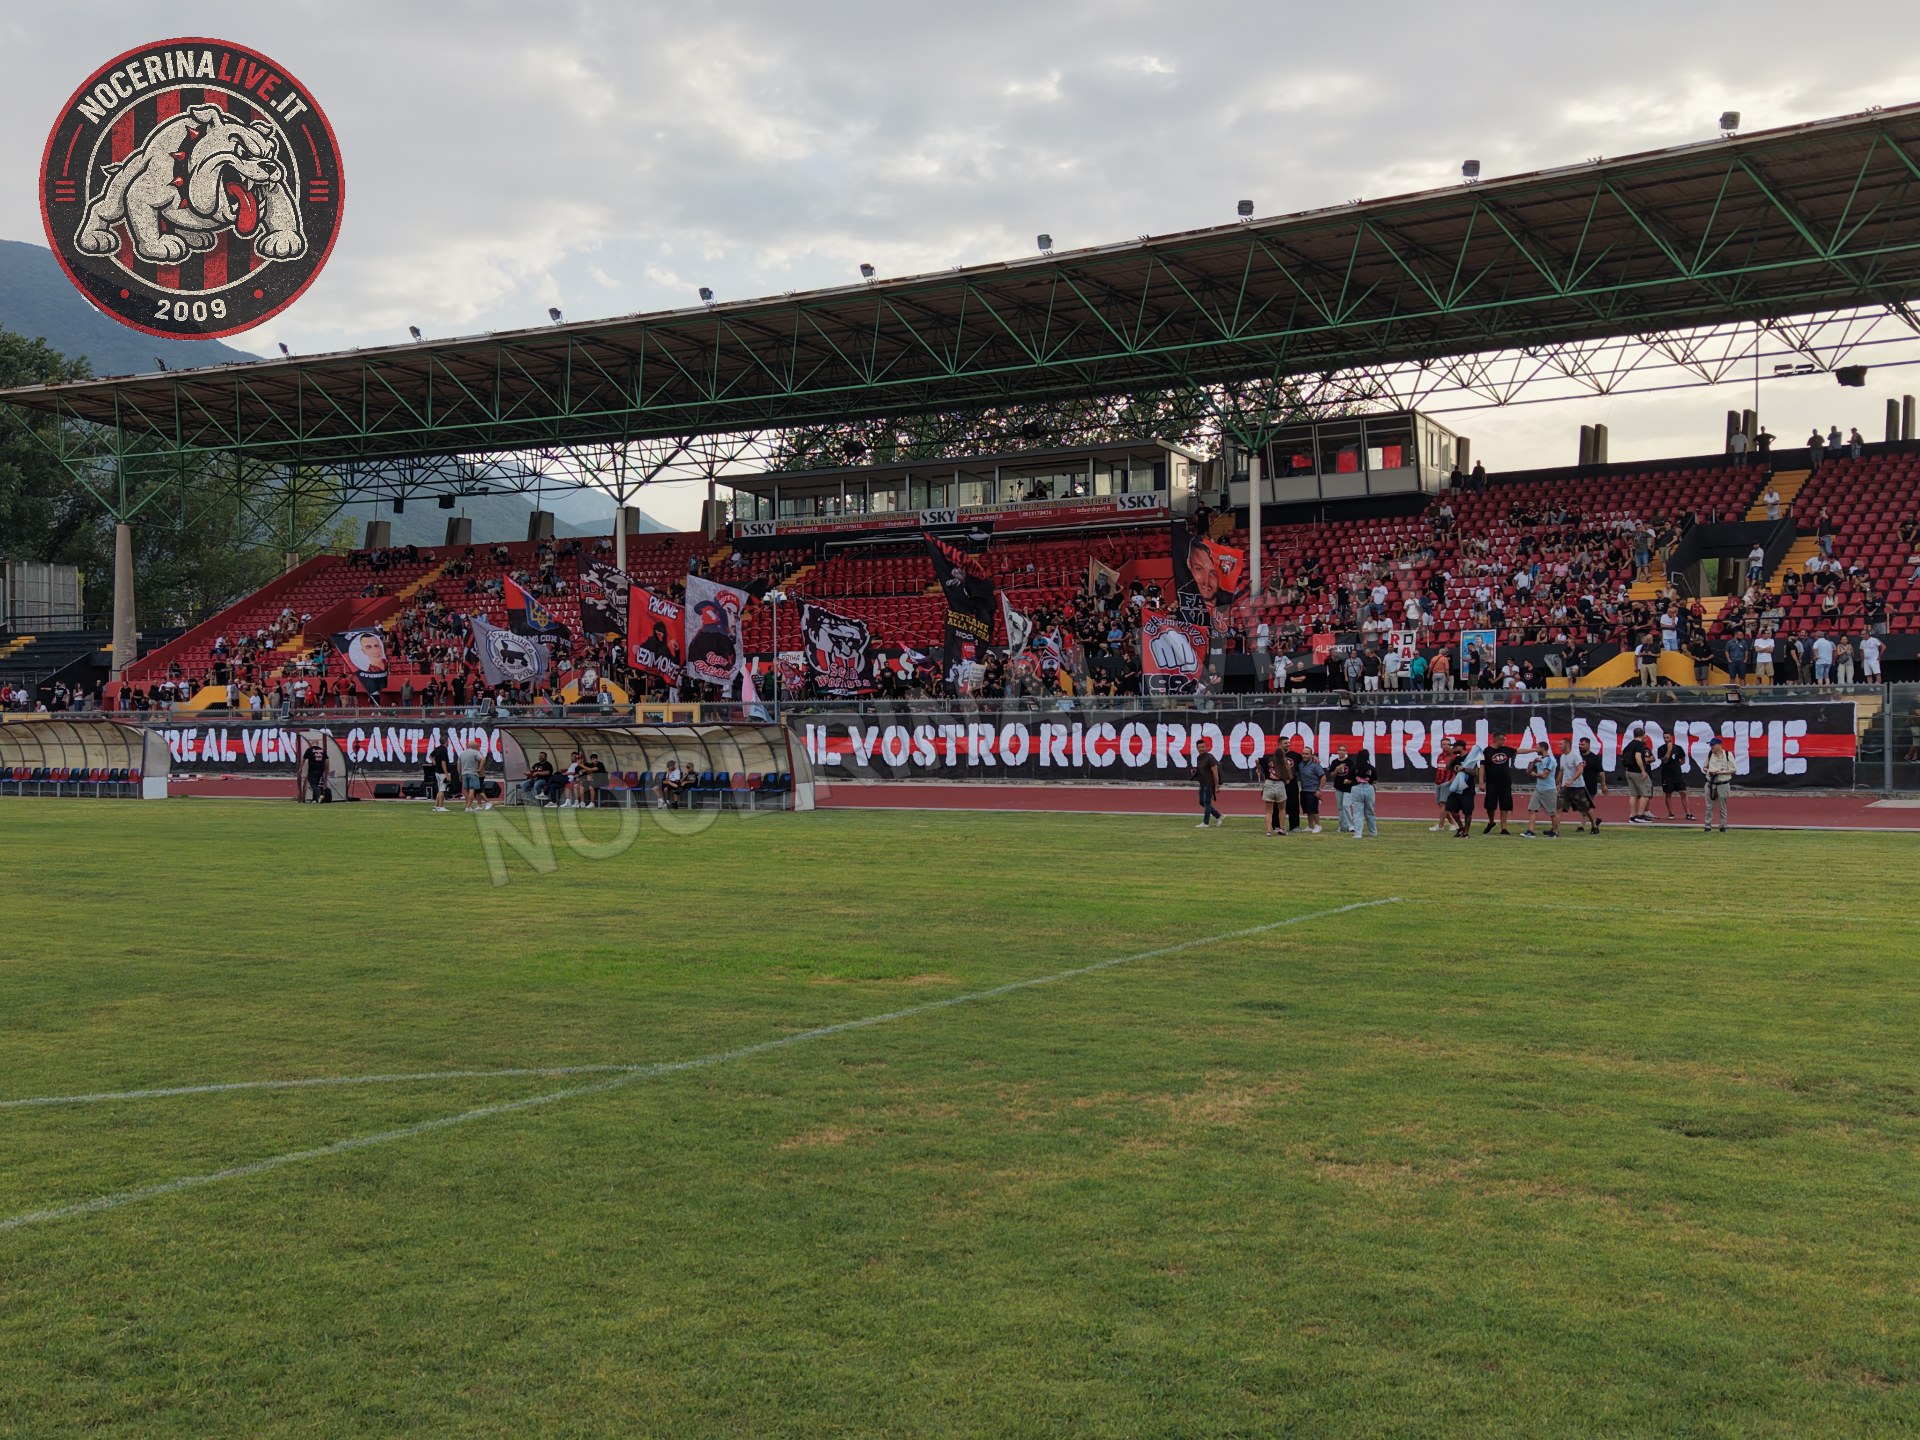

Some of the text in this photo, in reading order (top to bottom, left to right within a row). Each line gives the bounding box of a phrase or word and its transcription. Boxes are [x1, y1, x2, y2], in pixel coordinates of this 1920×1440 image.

[648, 595, 679, 620] RIONE
[806, 723, 841, 766] IL
[848, 723, 1030, 767] VOSTRO
[1039, 720, 1265, 770] RICORDO
[1279, 718, 1463, 770] OLTRE
